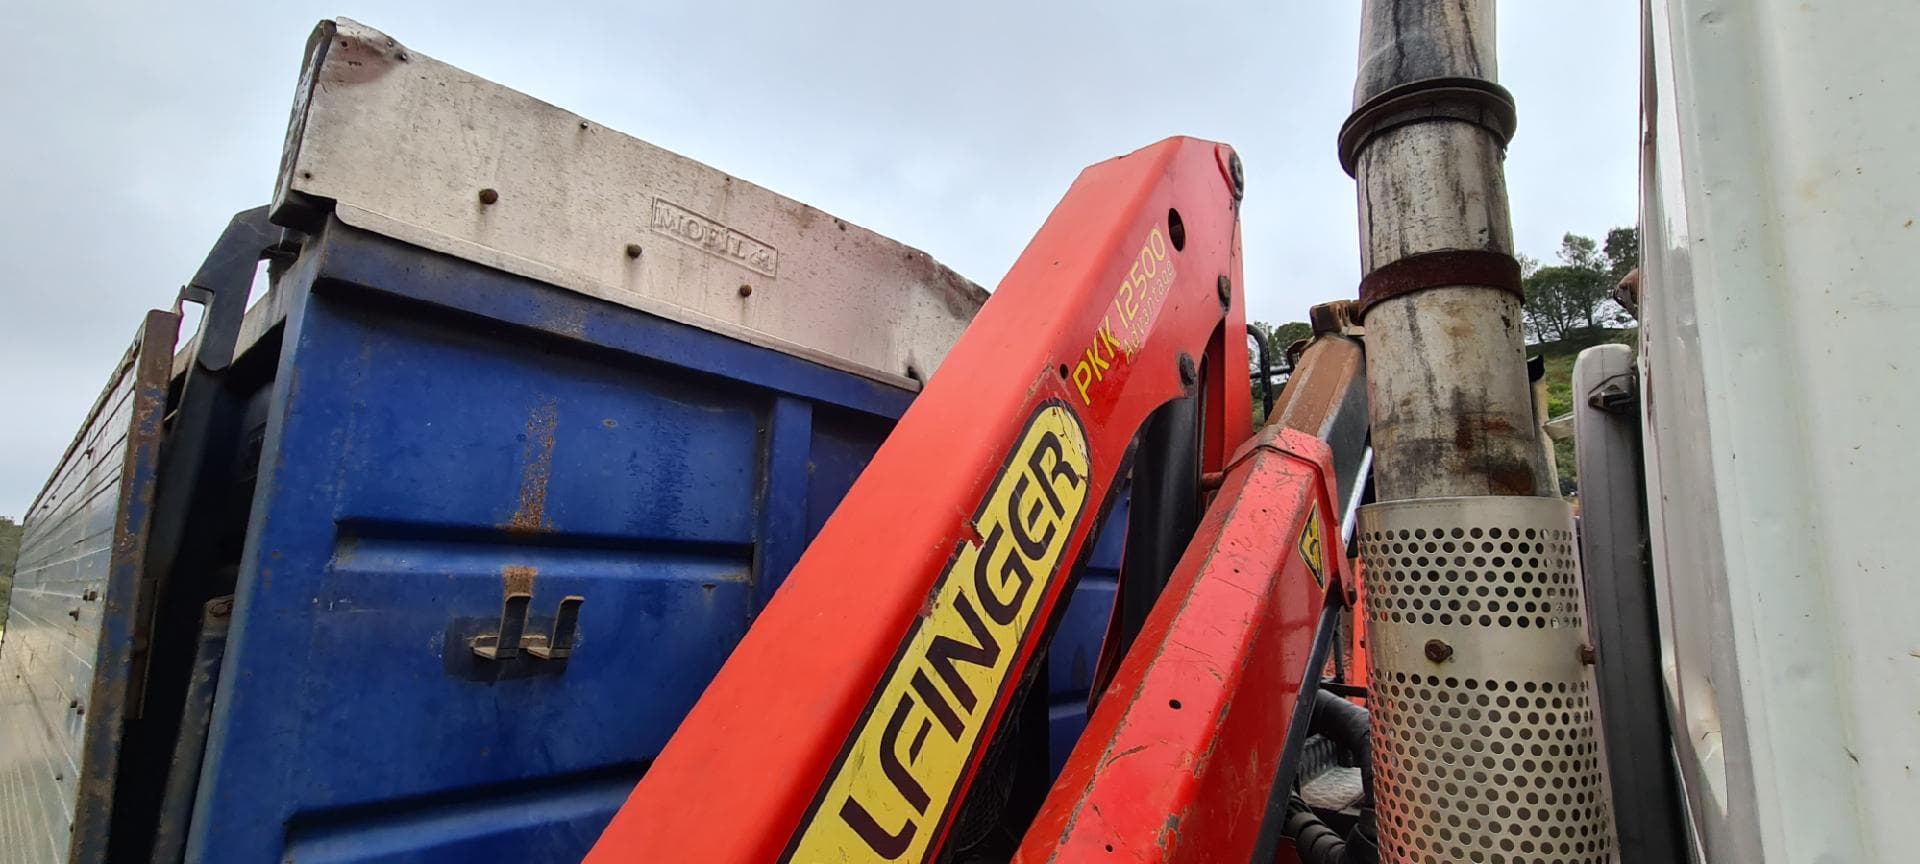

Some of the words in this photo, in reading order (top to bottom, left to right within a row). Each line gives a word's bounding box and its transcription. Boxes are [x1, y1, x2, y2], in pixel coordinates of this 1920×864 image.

[1072, 315, 1121, 406] PKK
[1114, 228, 1166, 329] 12500
[1122, 260, 1175, 365] Advantage
